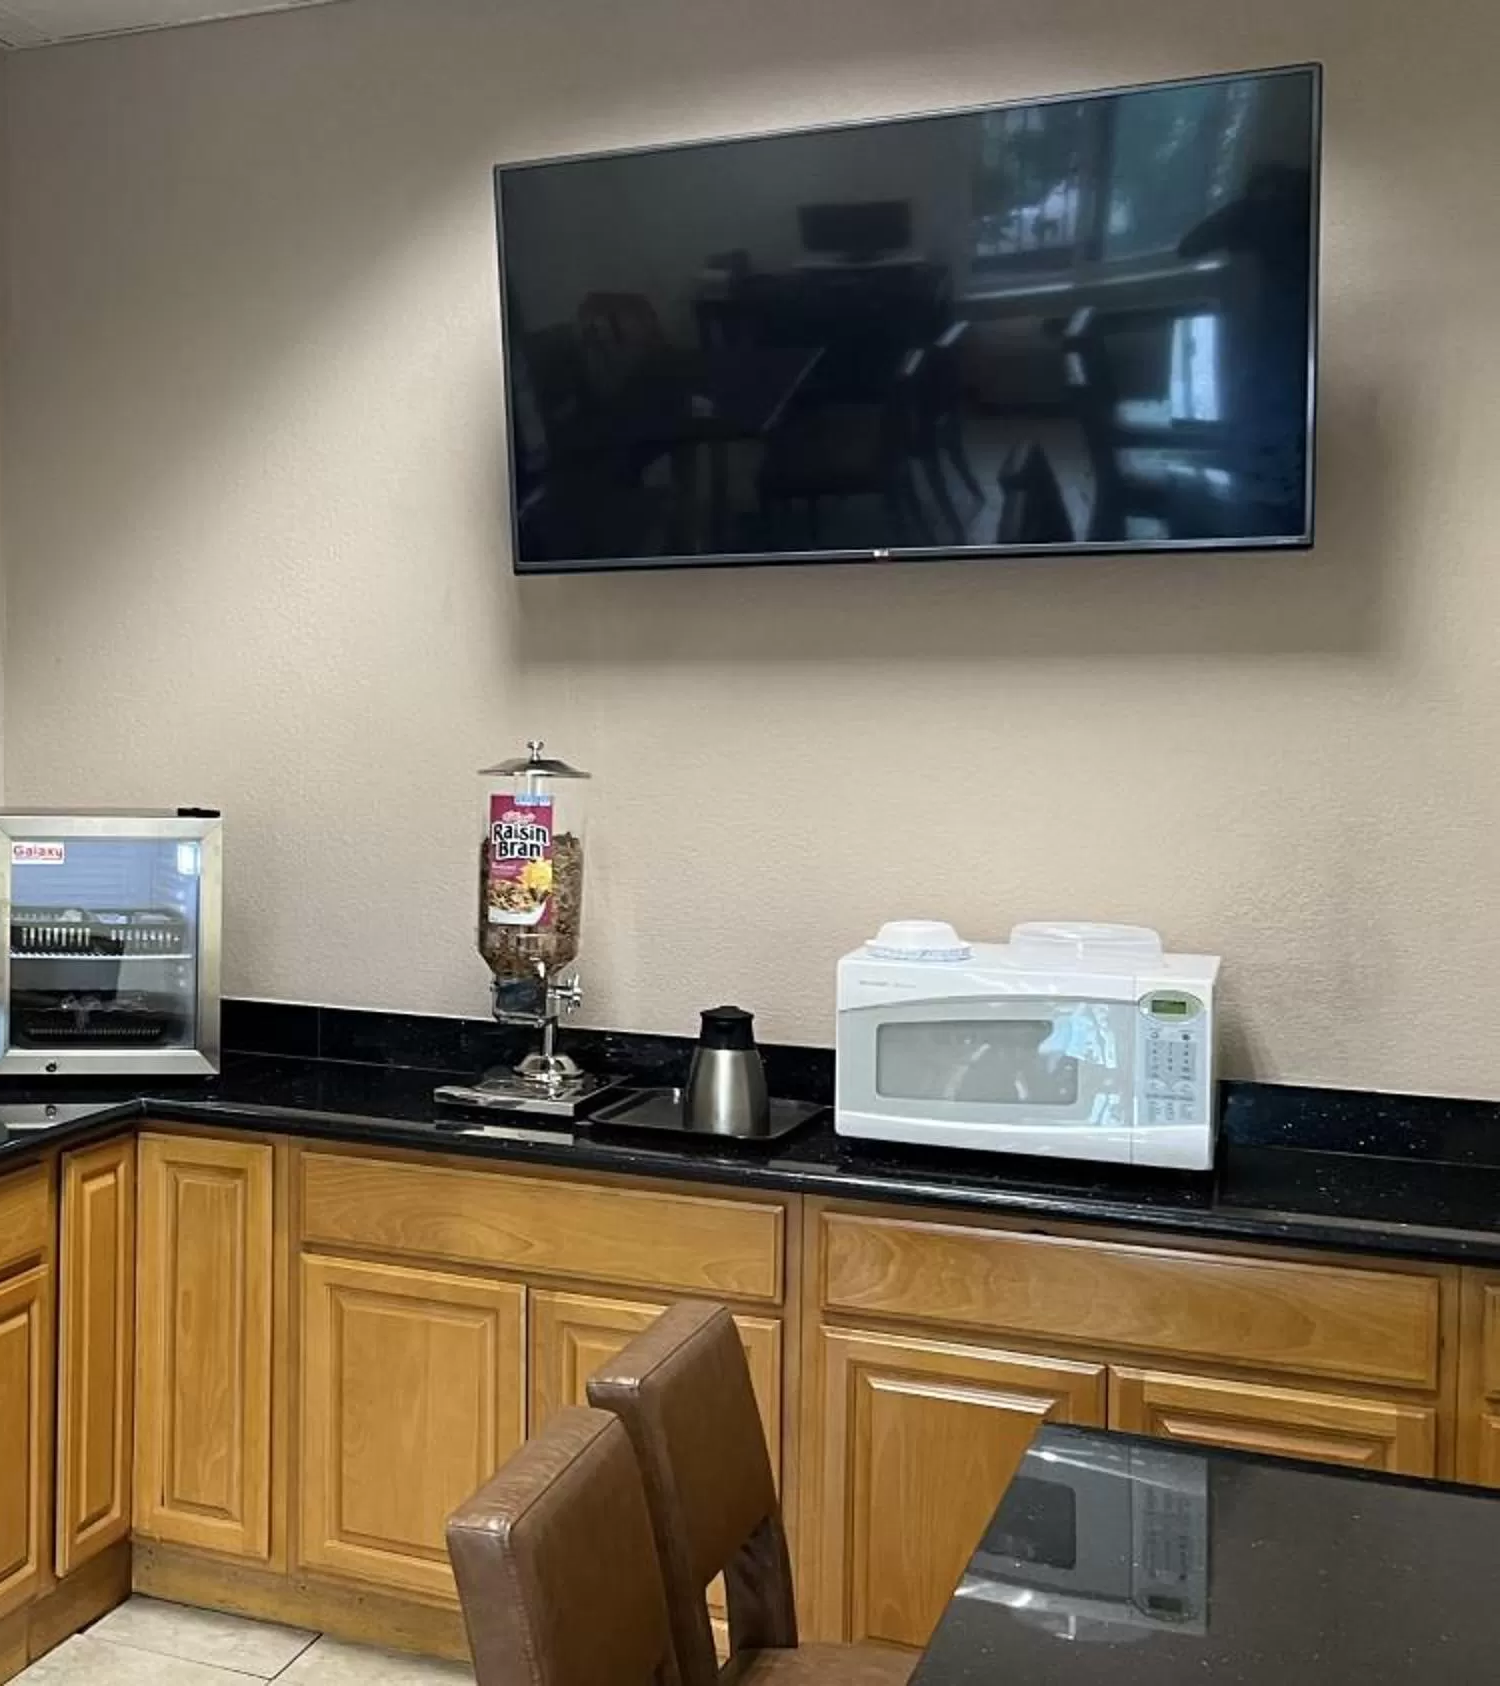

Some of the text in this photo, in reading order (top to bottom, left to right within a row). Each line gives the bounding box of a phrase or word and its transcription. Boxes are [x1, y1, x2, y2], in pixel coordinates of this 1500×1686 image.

[493, 823, 547, 844] Raisin
[13, 844, 63, 861] Galaxy
[498, 841, 541, 857] Bran
